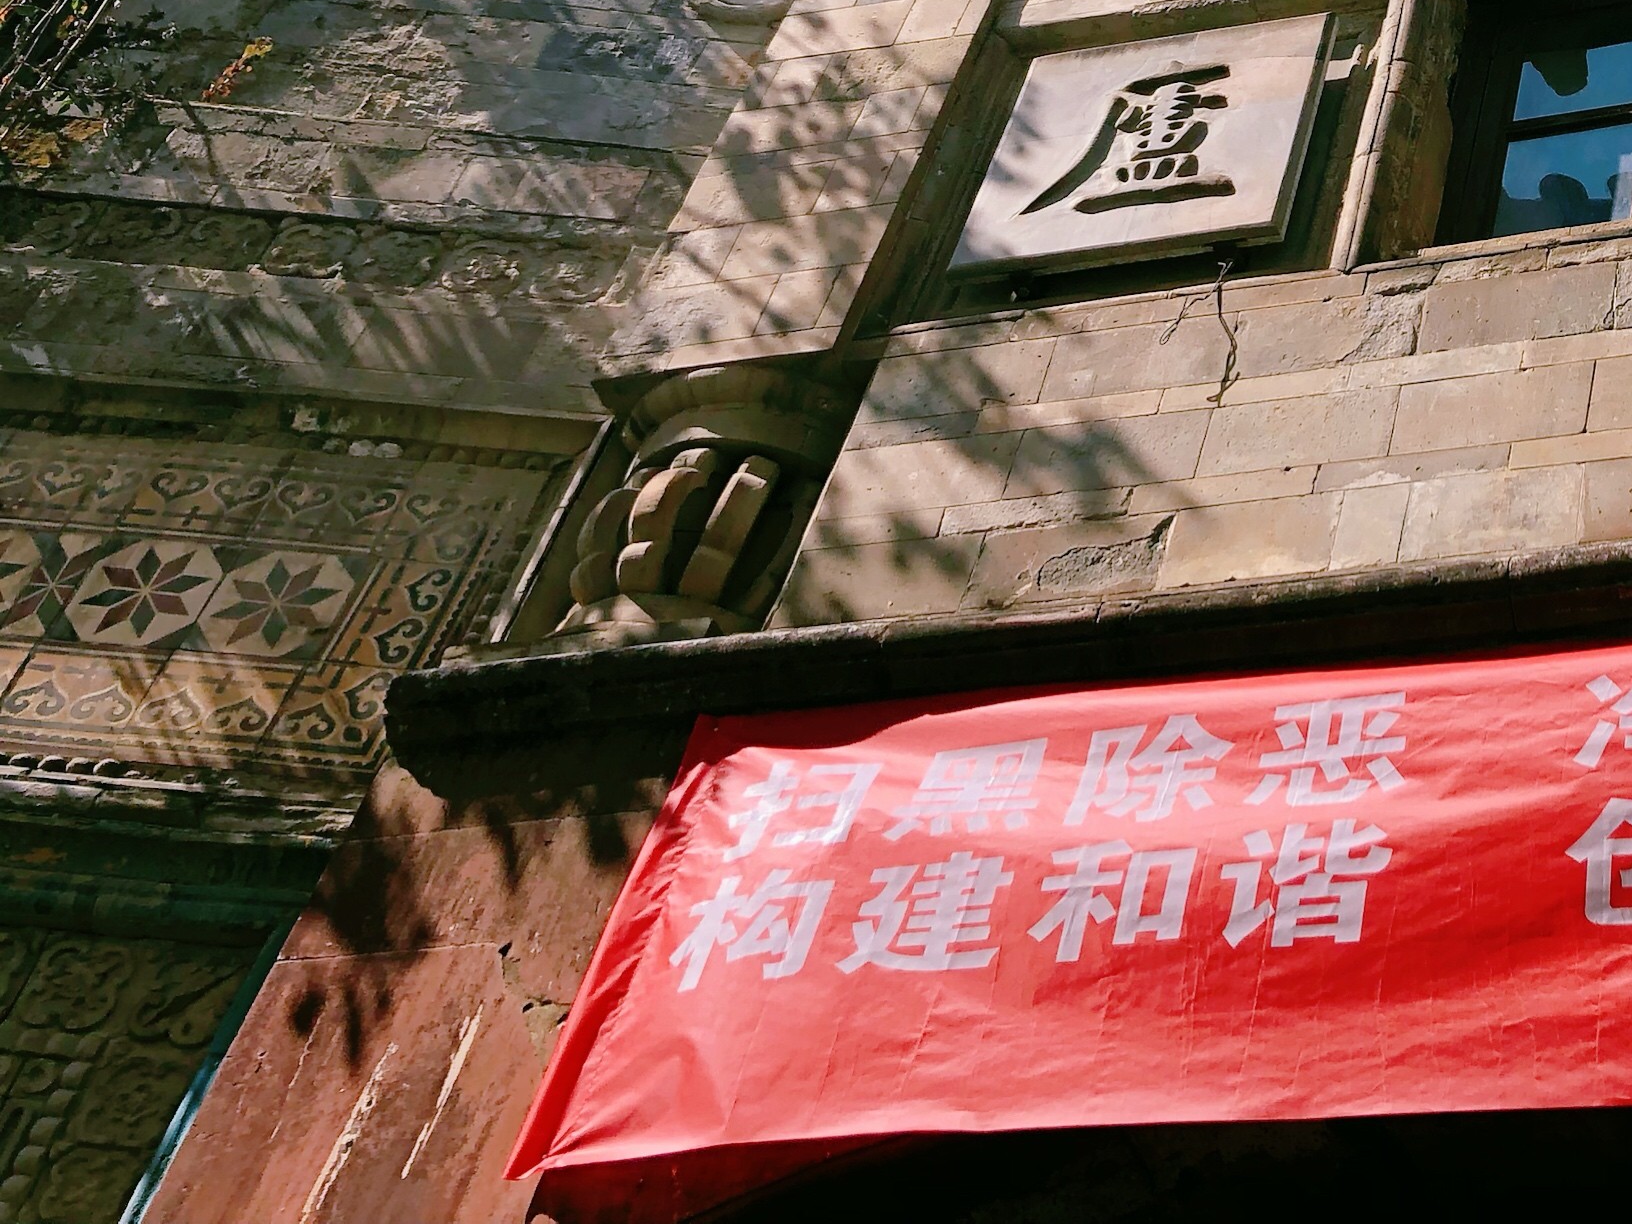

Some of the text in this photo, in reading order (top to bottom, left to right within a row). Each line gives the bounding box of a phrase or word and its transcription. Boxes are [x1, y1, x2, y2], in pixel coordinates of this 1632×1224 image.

[722, 691, 1407, 862] 扫黑除恶
[670, 818, 1394, 993] 构建和谐
